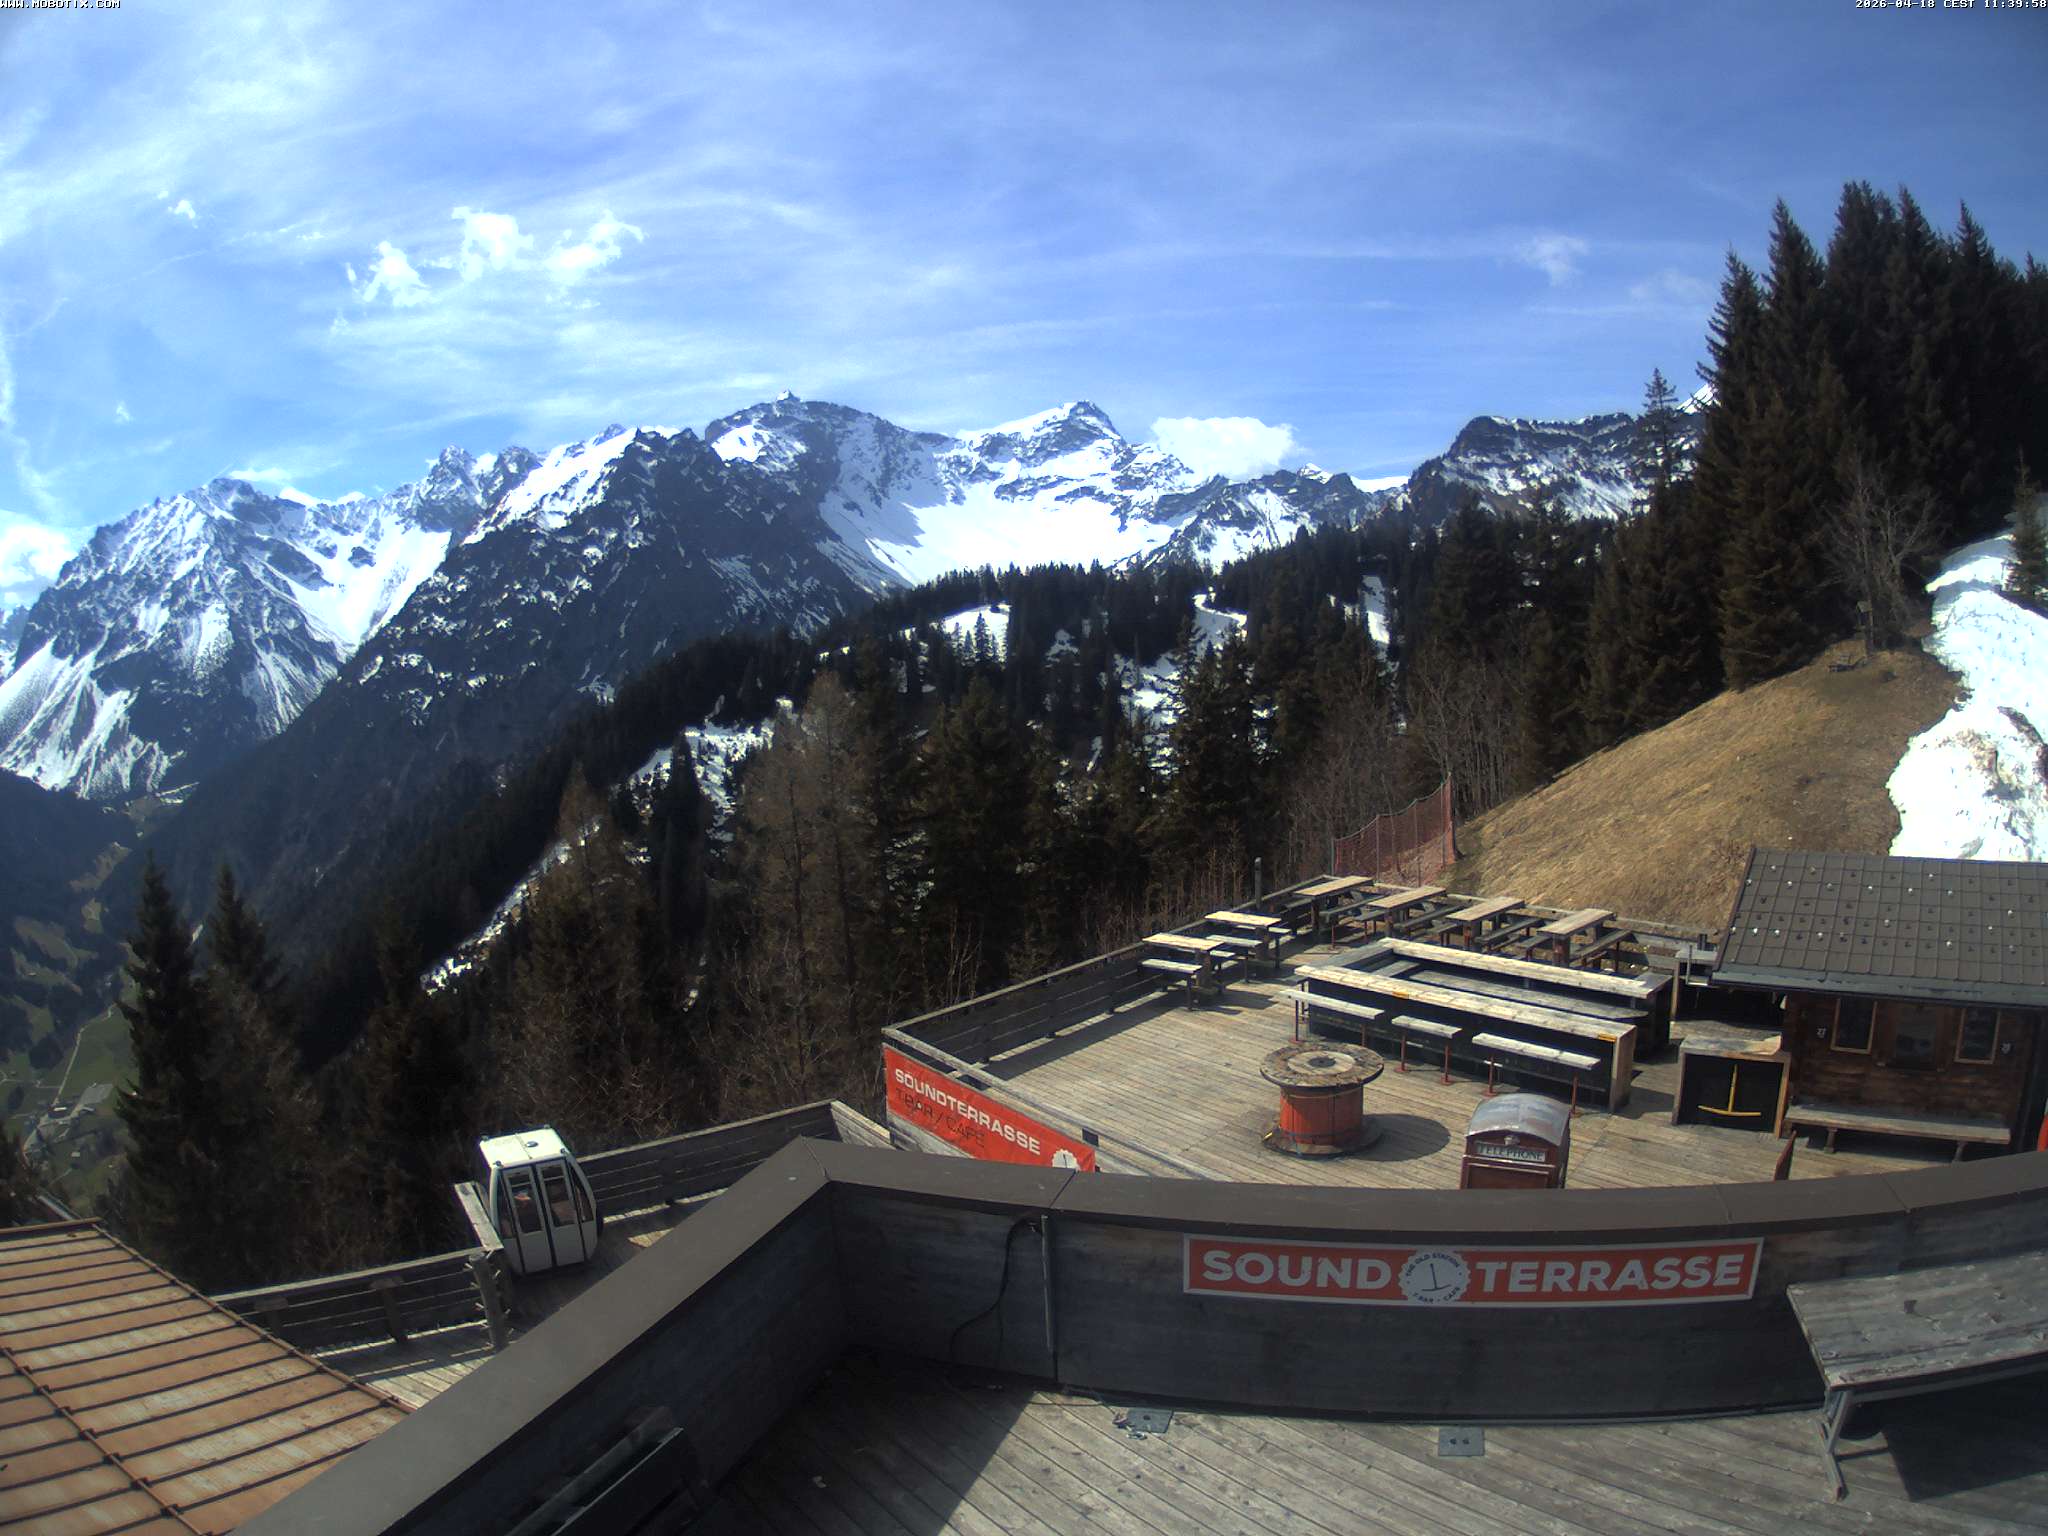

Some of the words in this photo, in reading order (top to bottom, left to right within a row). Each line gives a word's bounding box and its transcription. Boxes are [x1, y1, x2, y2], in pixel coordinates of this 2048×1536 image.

[895, 1068, 1041, 1155] SOUNDTERRASSE
[1479, 1144, 1544, 1161] TELEPHONE
[1201, 1249, 1390, 1291] SOUND
[1475, 1252, 1745, 1293] TERRASSE
